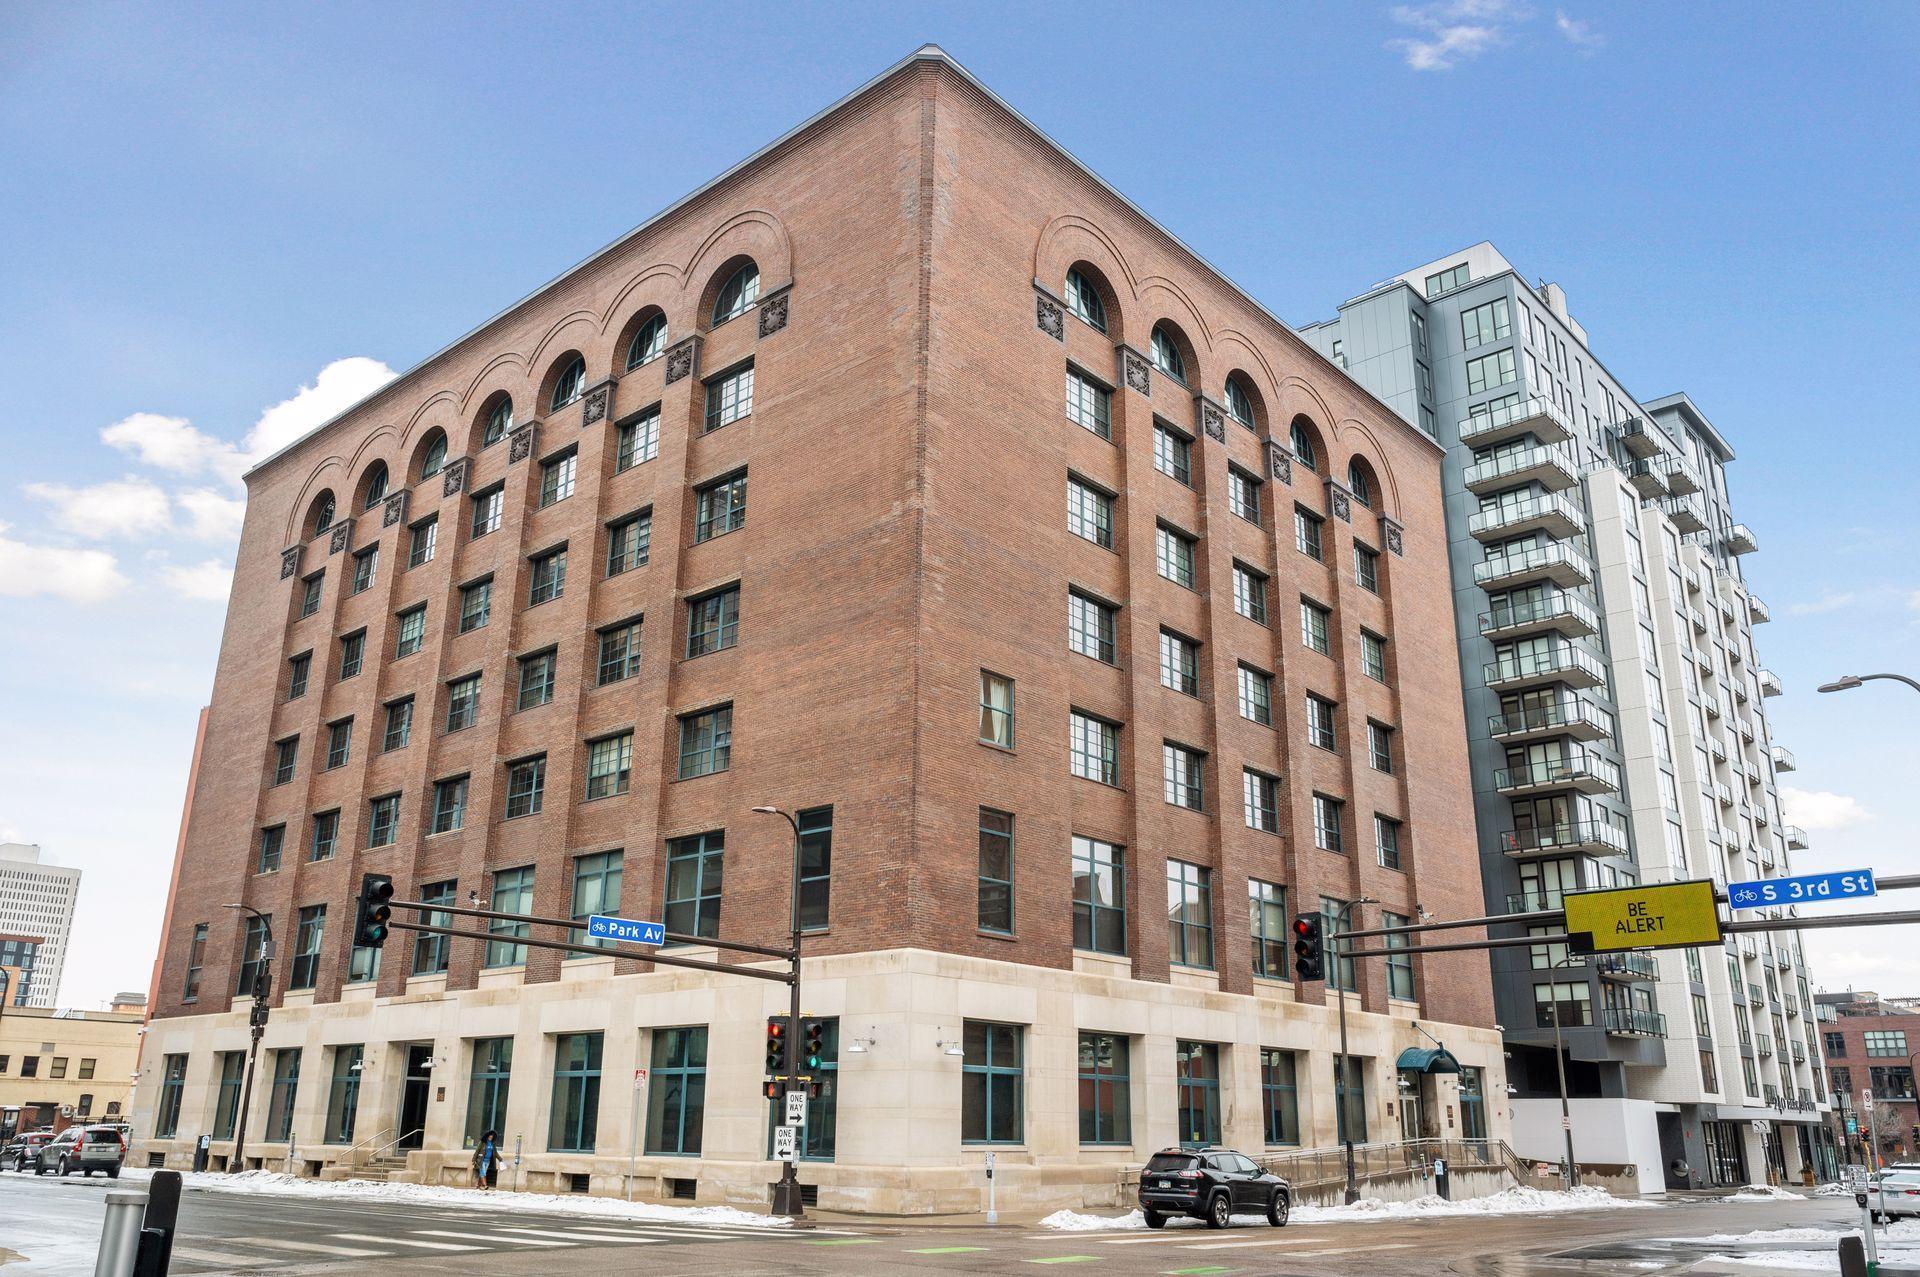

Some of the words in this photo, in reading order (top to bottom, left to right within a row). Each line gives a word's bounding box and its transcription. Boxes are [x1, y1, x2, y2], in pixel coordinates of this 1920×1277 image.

[1761, 884, 1777, 901] S
[1788, 879, 1831, 899] 3rd
[1841, 875, 1869, 893] St
[1627, 901, 1648, 917] BE
[1616, 916, 1665, 934] ALERT
[608, 922, 640, 938] Park
[644, 927, 661, 941] Av
[789, 1094, 803, 1103] ONE
[789, 1103, 804, 1112] WAY
[778, 1129, 792, 1138] ONE
[777, 1138, 793, 1147] WAY
